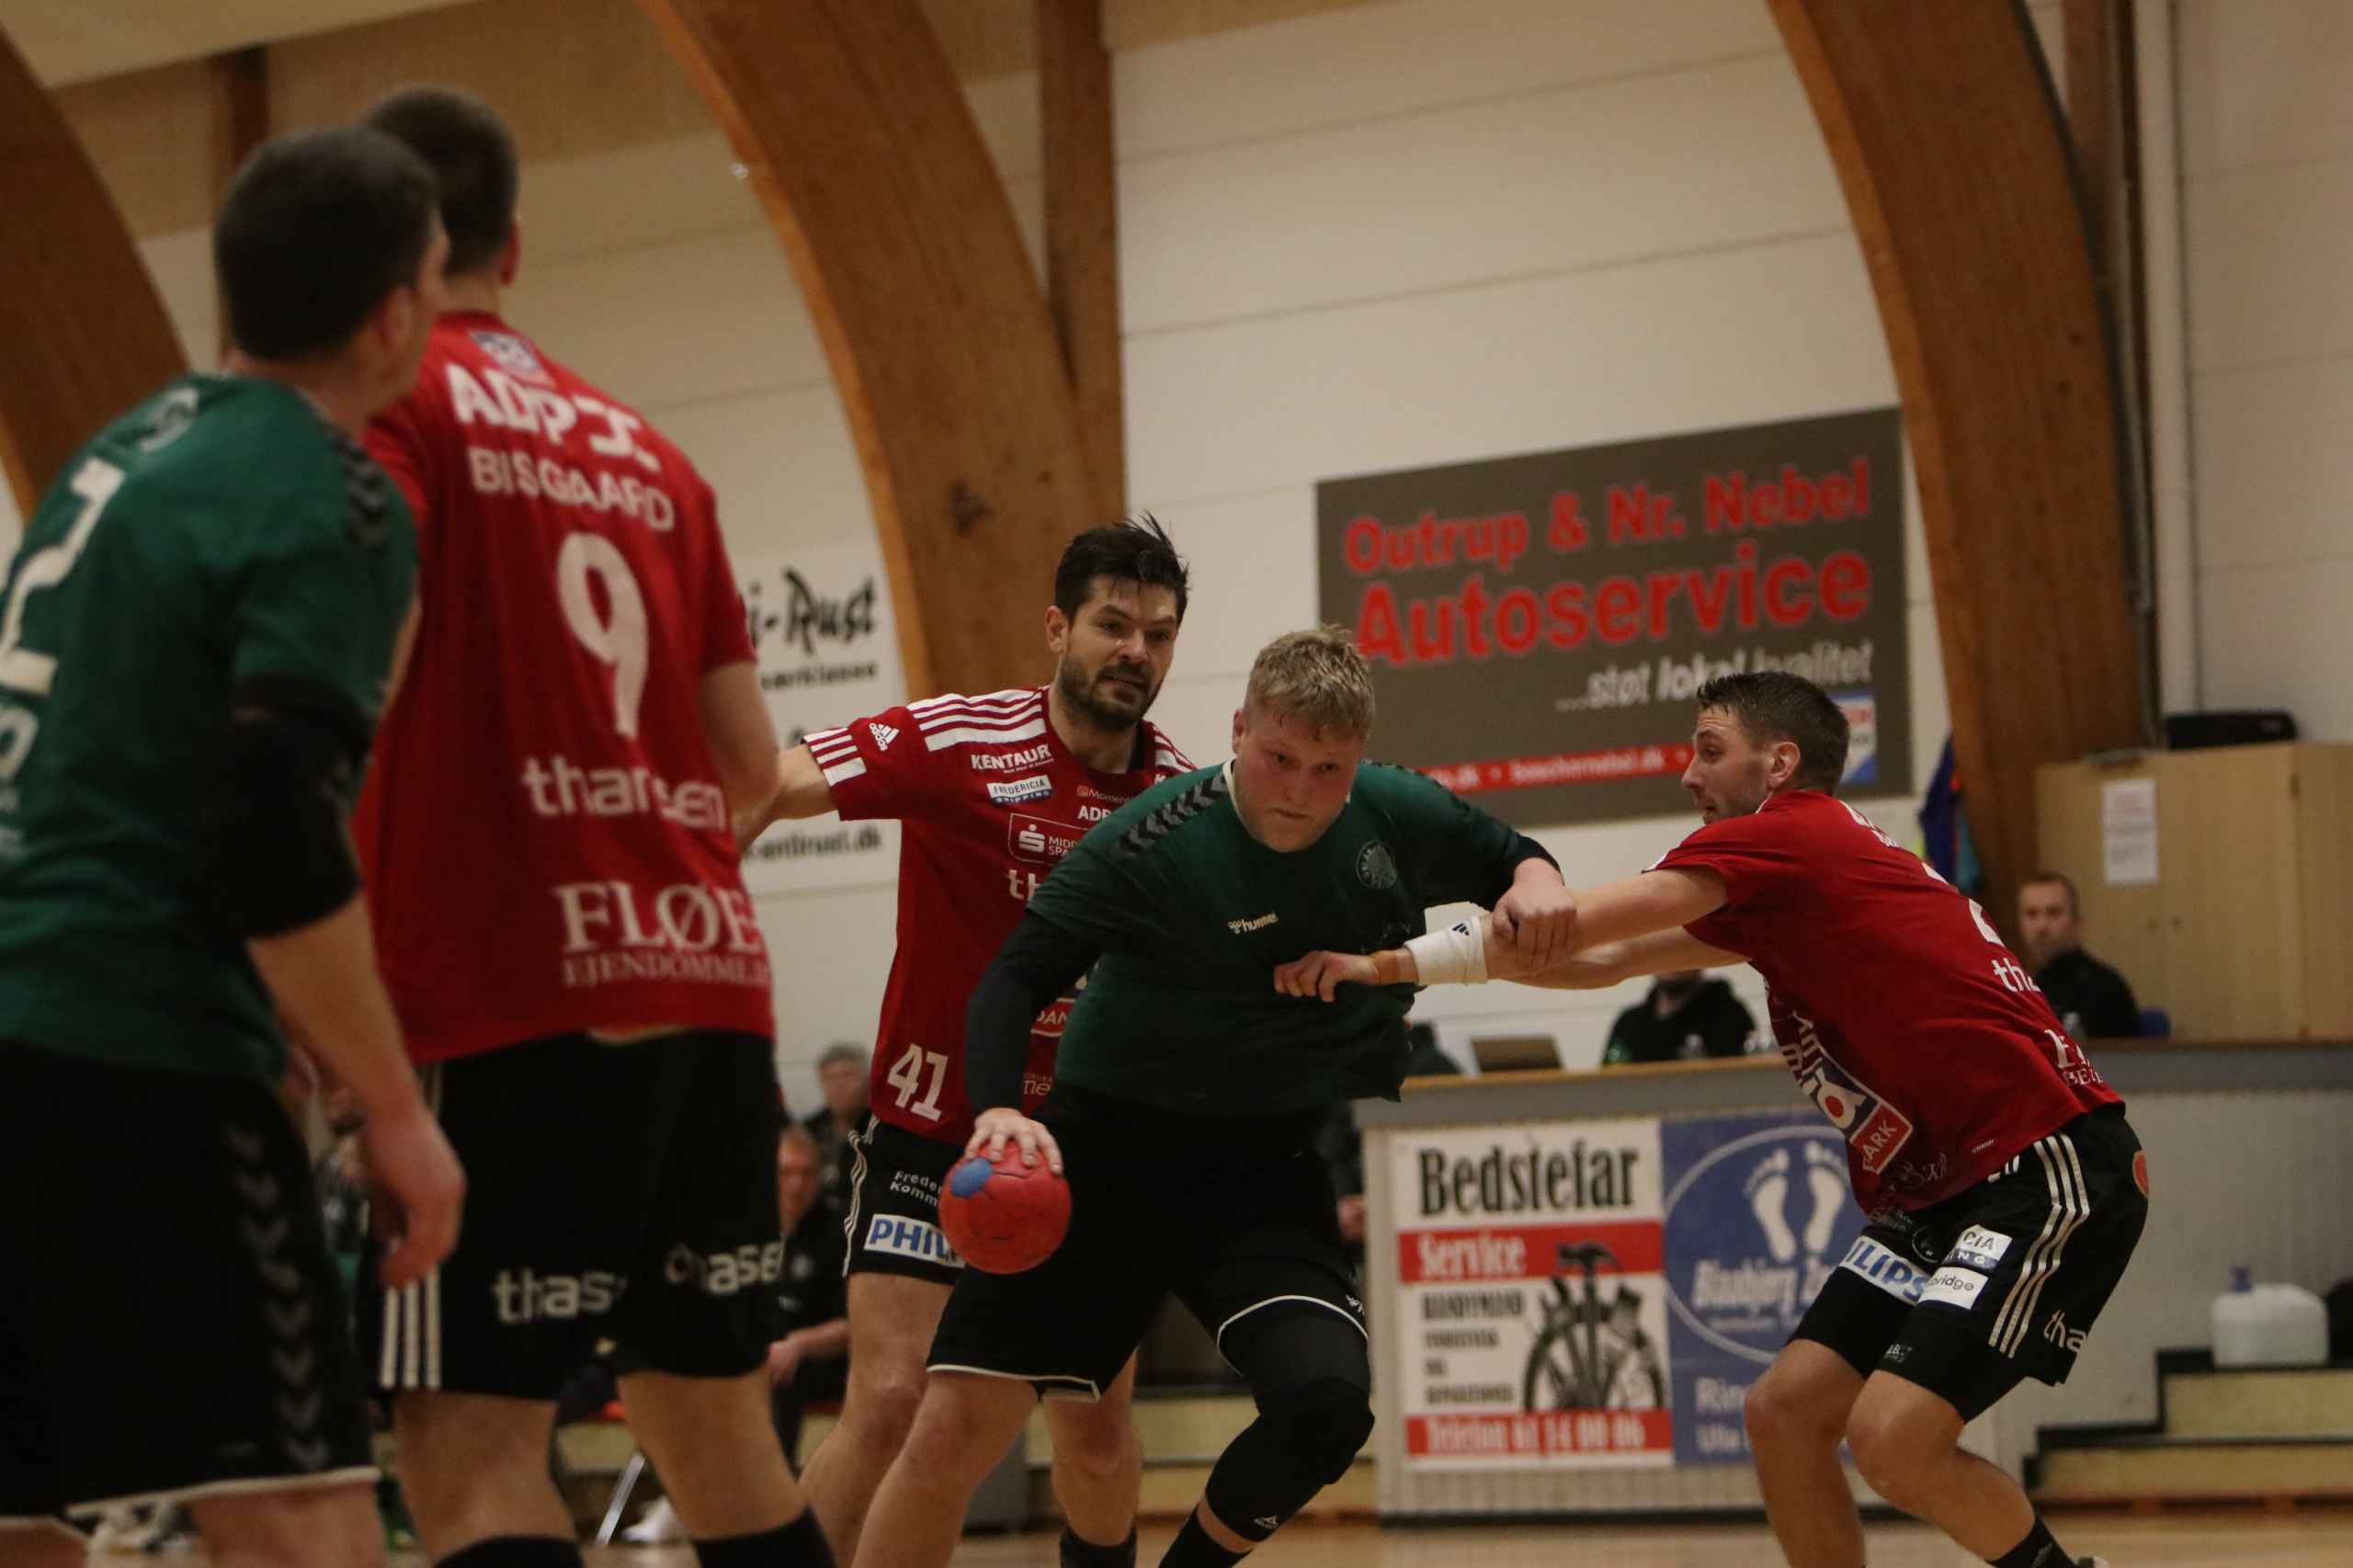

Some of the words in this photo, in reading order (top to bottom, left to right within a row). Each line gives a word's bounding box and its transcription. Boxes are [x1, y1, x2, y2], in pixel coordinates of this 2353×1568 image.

[1343, 511, 1529, 574] Outrup
[1548, 491, 1587, 551] &
[1608, 482, 1688, 545] Nr.
[1703, 459, 1870, 533] Nebel
[557, 531, 648, 736] 9
[1354, 541, 1871, 665] Autoservice
[971, 744, 1052, 770] KENTAUR
[886, 1042, 949, 1122] 41
[1418, 1140, 1640, 1216] Bedstefar
[1416, 1231, 1527, 1278] Service
[1962, 1226, 1995, 1252] CIA
